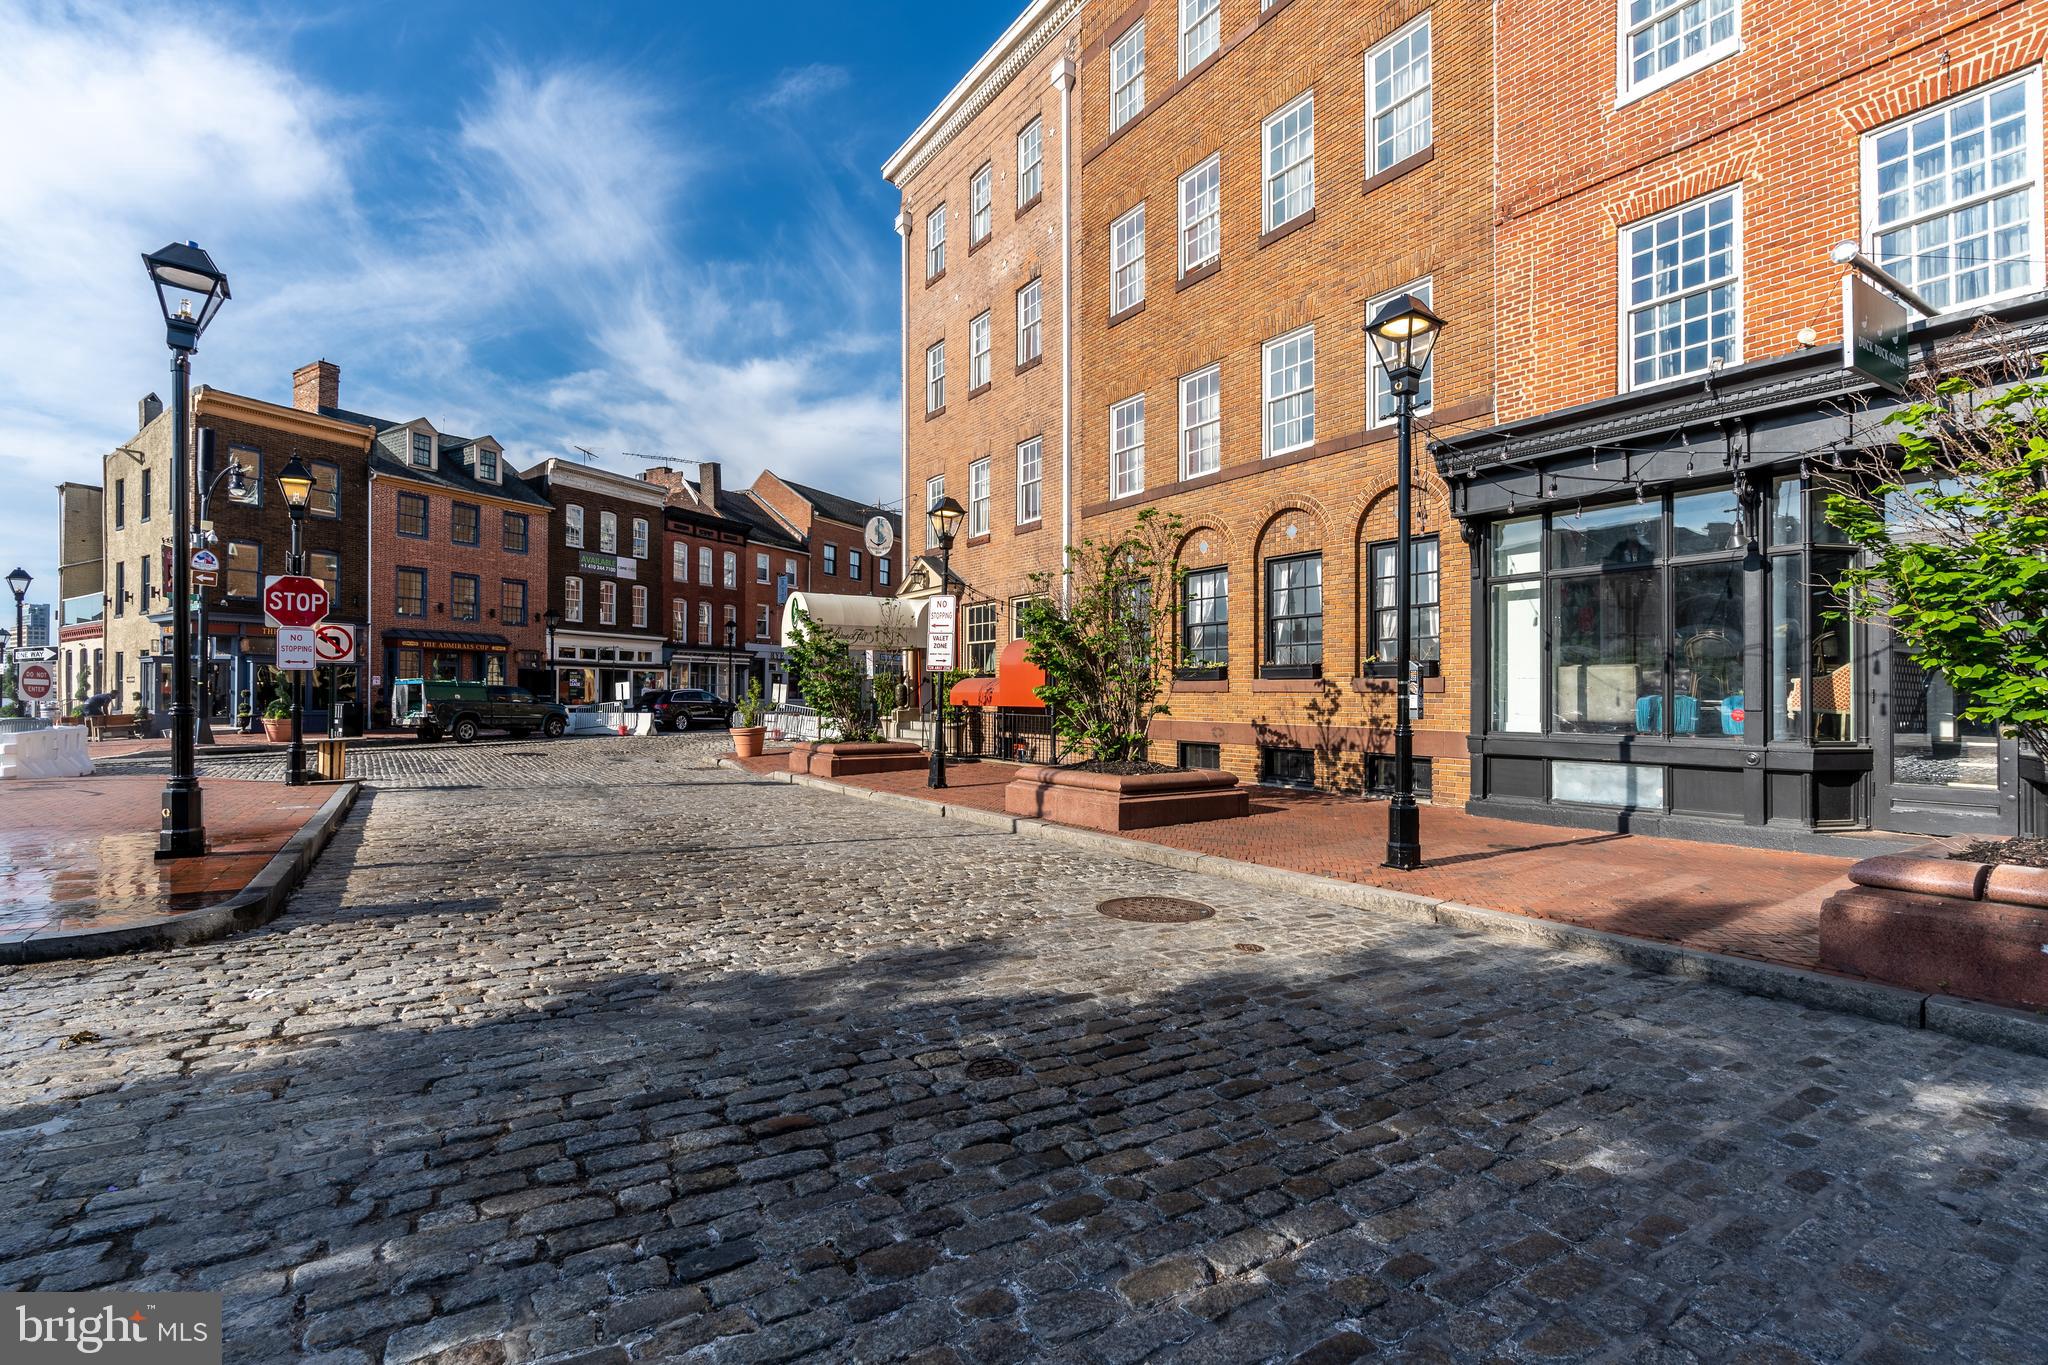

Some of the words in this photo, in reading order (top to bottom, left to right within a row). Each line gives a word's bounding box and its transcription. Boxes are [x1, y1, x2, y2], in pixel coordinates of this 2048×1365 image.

[1859, 337, 1873, 352] DUCK
[1875, 345, 1888, 360] DUCK
[1890, 353, 1905, 369] GOOSE
[581, 556, 616, 566] AVAILABLE
[269, 591, 325, 612] STOP
[936, 600, 948, 608] NO
[930, 612, 952, 620] STOPPING
[290, 634, 303, 642] NO
[280, 645, 313, 653] STOPPING
[438, 642, 475, 651] ADMIRALS
